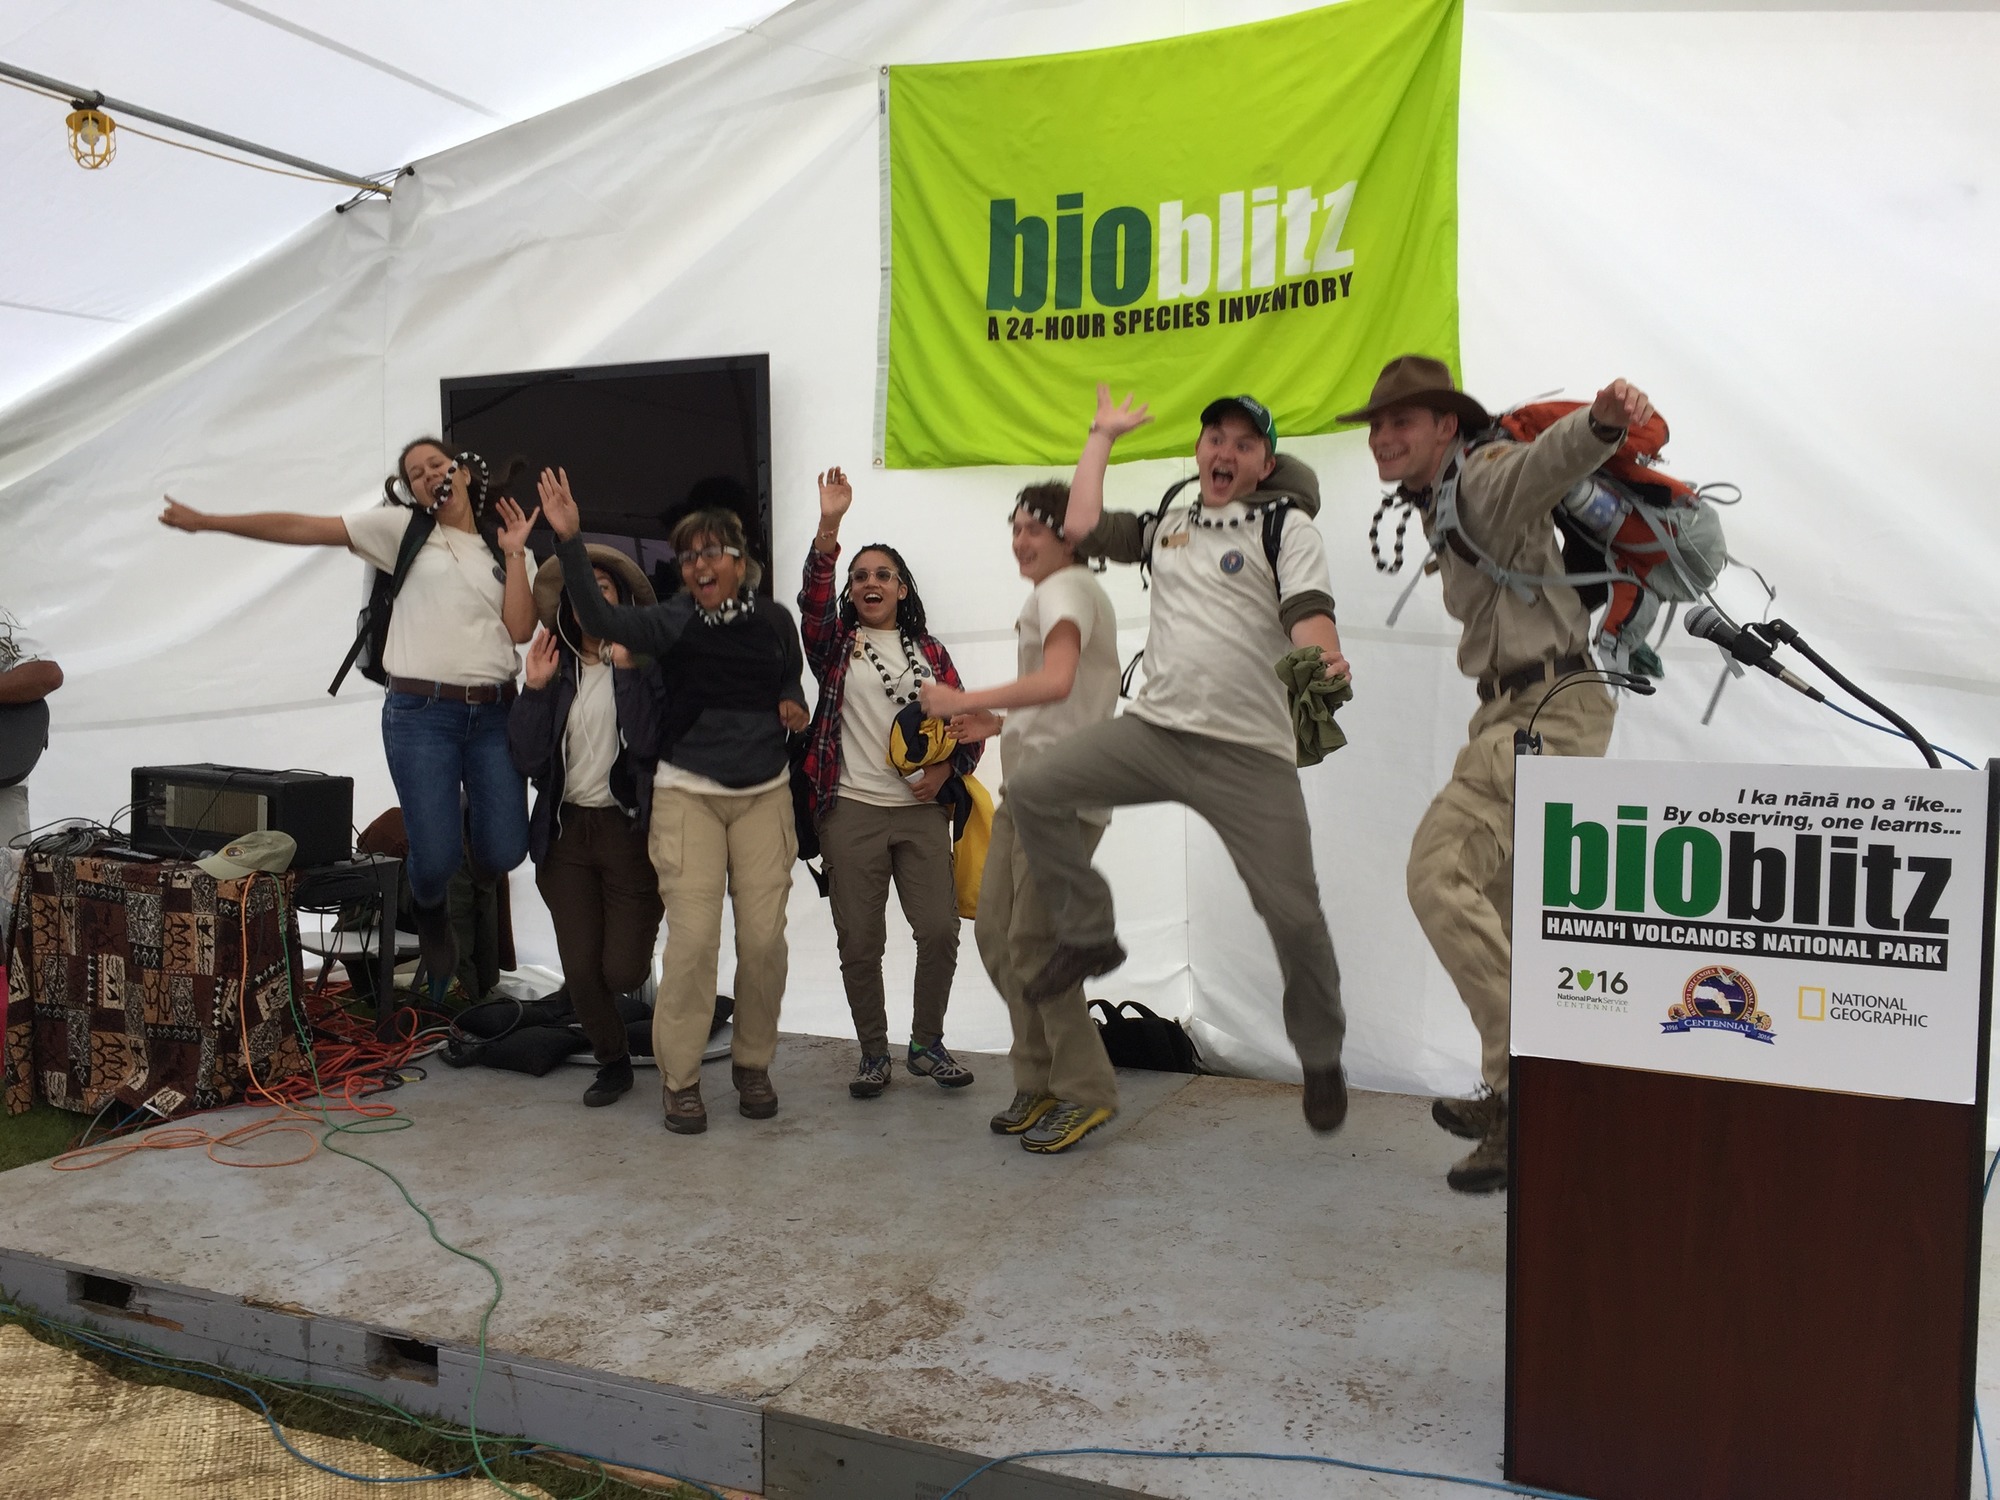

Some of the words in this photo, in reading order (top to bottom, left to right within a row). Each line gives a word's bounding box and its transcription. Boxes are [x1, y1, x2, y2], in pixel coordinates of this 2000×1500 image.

[986, 181, 1357, 313] bioblitz
[987, 317, 999, 341] A
[1006, 315, 1105, 341] 24-HOUR
[1113, 301, 1210, 335] SPECIES
[1219, 272, 1353, 324] INVENTORY
[1737, 789, 1746, 804] I
[1751, 790, 1777, 806] ka
[1846, 796, 1875, 810] no
[1882, 799, 1896, 810] a
[1663, 806, 1692, 825] By
[1698, 808, 1814, 832] observing,
[1821, 816, 1865, 830] one
[1871, 816, 1962, 835] learns...
[1542, 802, 1952, 934] bioblitz
[1633, 923, 1757, 951] VOLCANOES
[1762, 933, 1873, 960] NATIONAL
[1878, 942, 1943, 965] PARK
[1556, 1000, 1629, 1014] CENTENNIAL
[1557, 993, 1586, 1002] National
[1586, 995, 1603, 1004] Park
[1603, 997, 1629, 1006] Service
[1831, 991, 1908, 1011] NATIONAL
[1683, 1019, 1752, 1033] CENTENNIAL
[1830, 1007, 1929, 1028] GEOGRAPHIC
